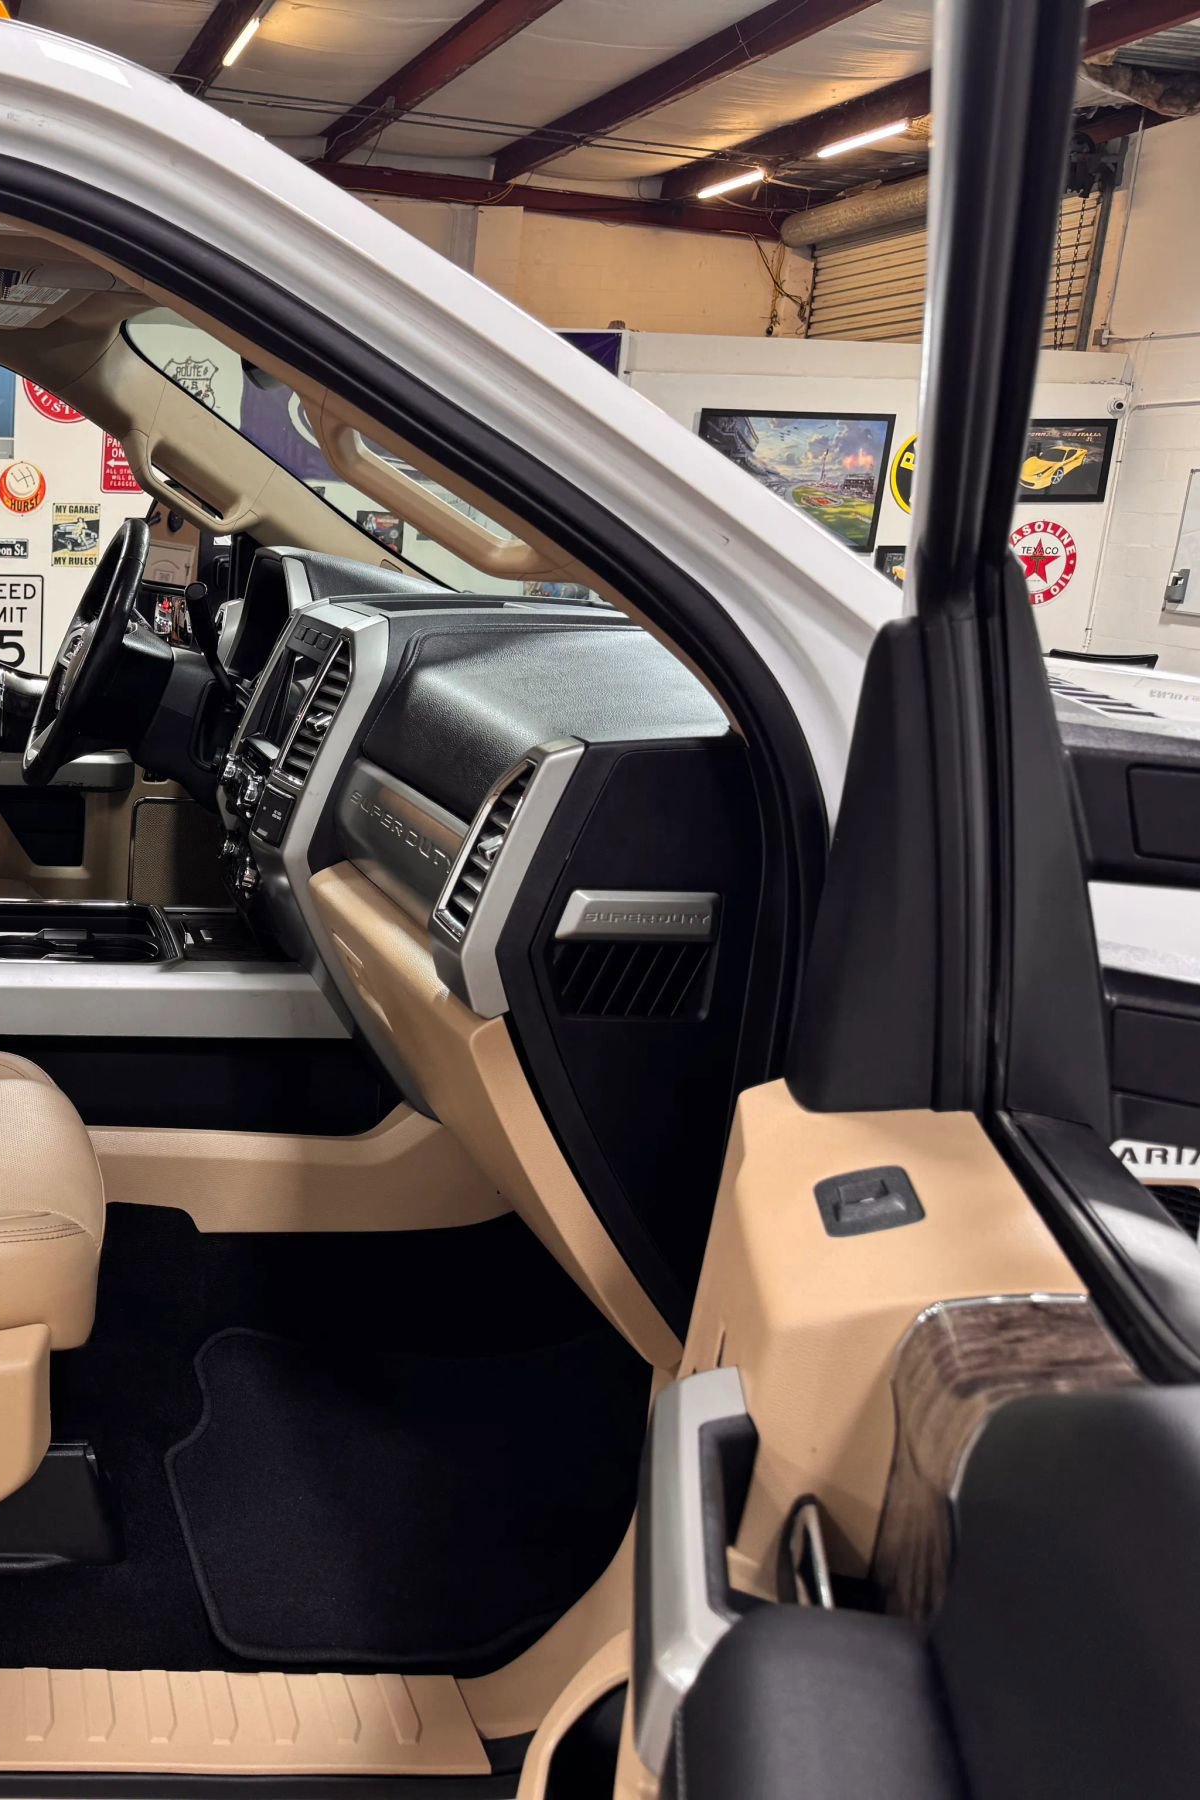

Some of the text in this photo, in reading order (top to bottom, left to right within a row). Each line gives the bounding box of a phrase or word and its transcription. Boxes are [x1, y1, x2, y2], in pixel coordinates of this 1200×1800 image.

[176, 365, 203, 377] ROUTE
[31, 383, 77, 415] MUST
[11, 492, 40, 512] HURST
[55, 505, 98, 514] MY GARAGE
[1011, 521, 1076, 555] ASOLINE
[14, 544, 27, 555] St.
[1021, 546, 1059, 555] TEXACO
[54, 557, 97, 565] MY RULES!
[1050, 573, 1073, 595] OIL
[350, 790, 403, 837] SUPER
